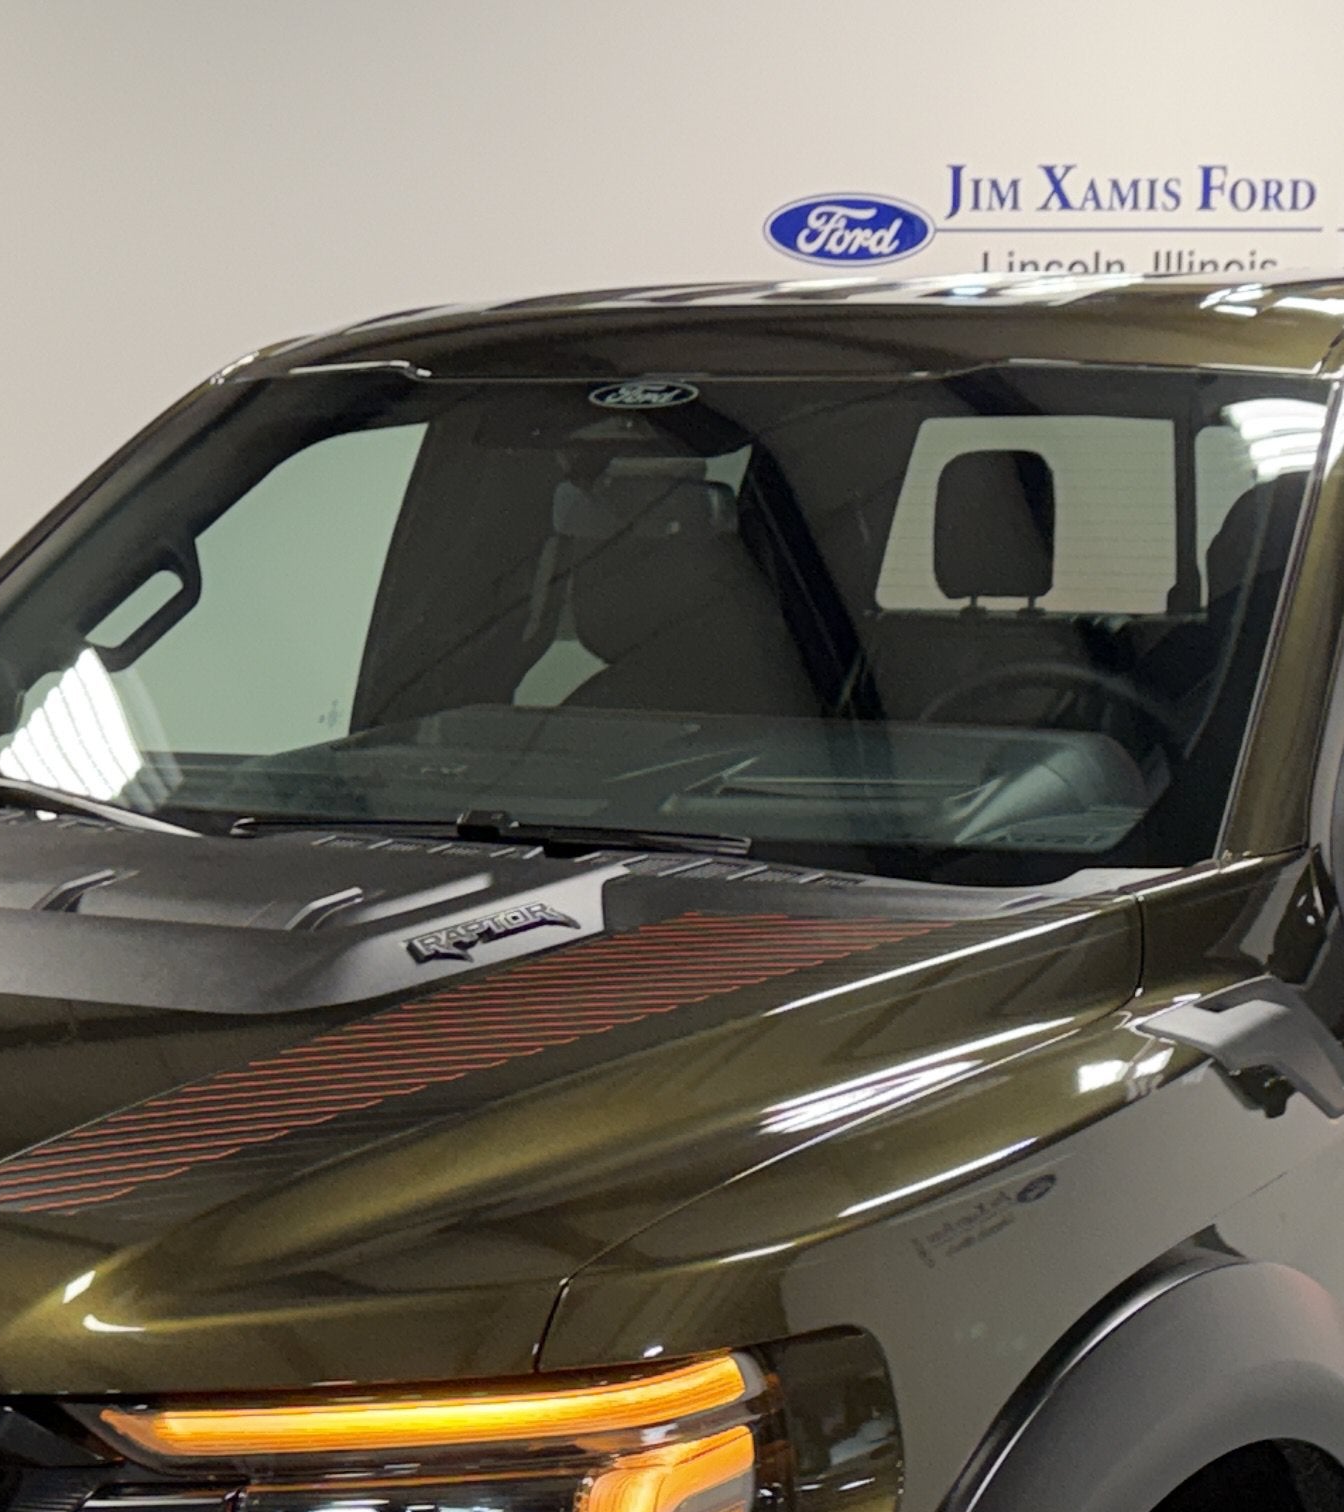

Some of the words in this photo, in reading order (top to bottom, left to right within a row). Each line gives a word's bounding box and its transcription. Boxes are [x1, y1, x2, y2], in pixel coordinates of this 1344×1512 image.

[945, 165, 1021, 221] JIM
[1036, 165, 1182, 212] XAMIS
[1197, 165, 1317, 213] FORD
[981, 250, 1126, 273] Lincoln
[406, 903, 581, 964] RAPTOR
